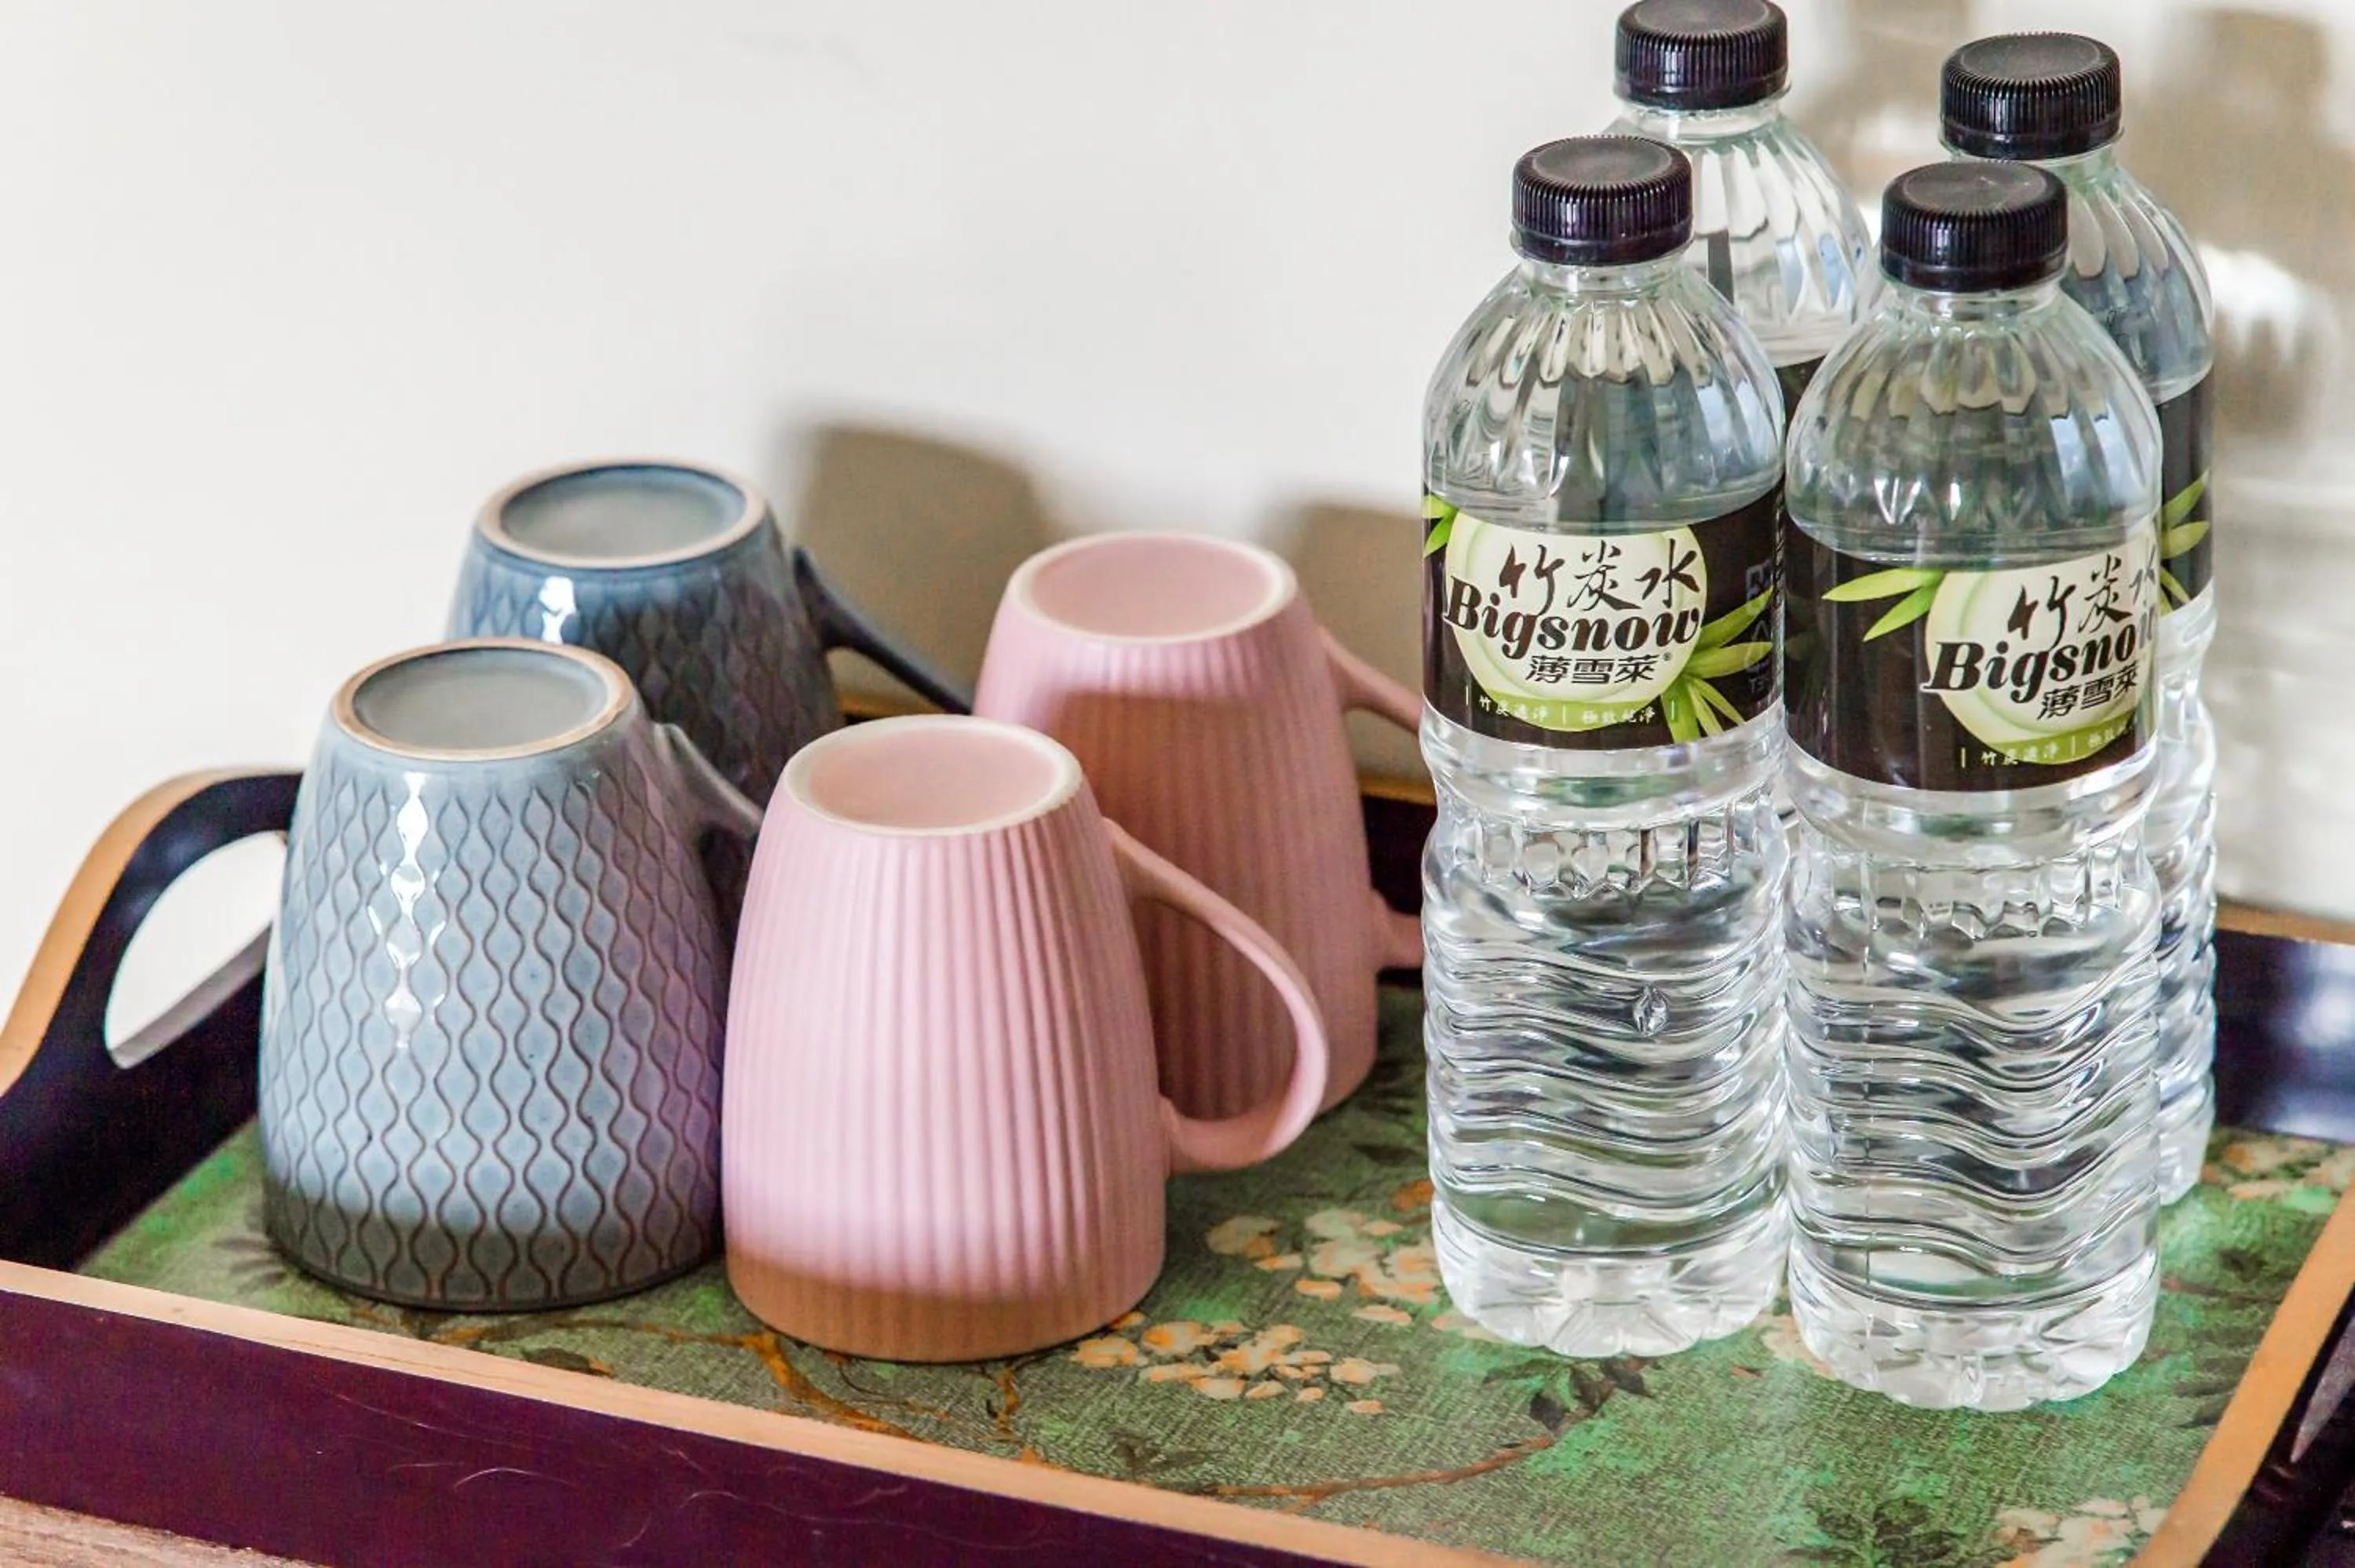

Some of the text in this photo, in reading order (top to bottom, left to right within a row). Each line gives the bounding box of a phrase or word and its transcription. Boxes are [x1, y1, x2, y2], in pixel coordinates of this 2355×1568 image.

[1499, 538, 1700, 615] 竹炭水
[1445, 576, 1701, 659] Bigsnow
[1525, 655, 1659, 684] 薄雪萊
[2036, 662, 2141, 720] 薄雪萊
